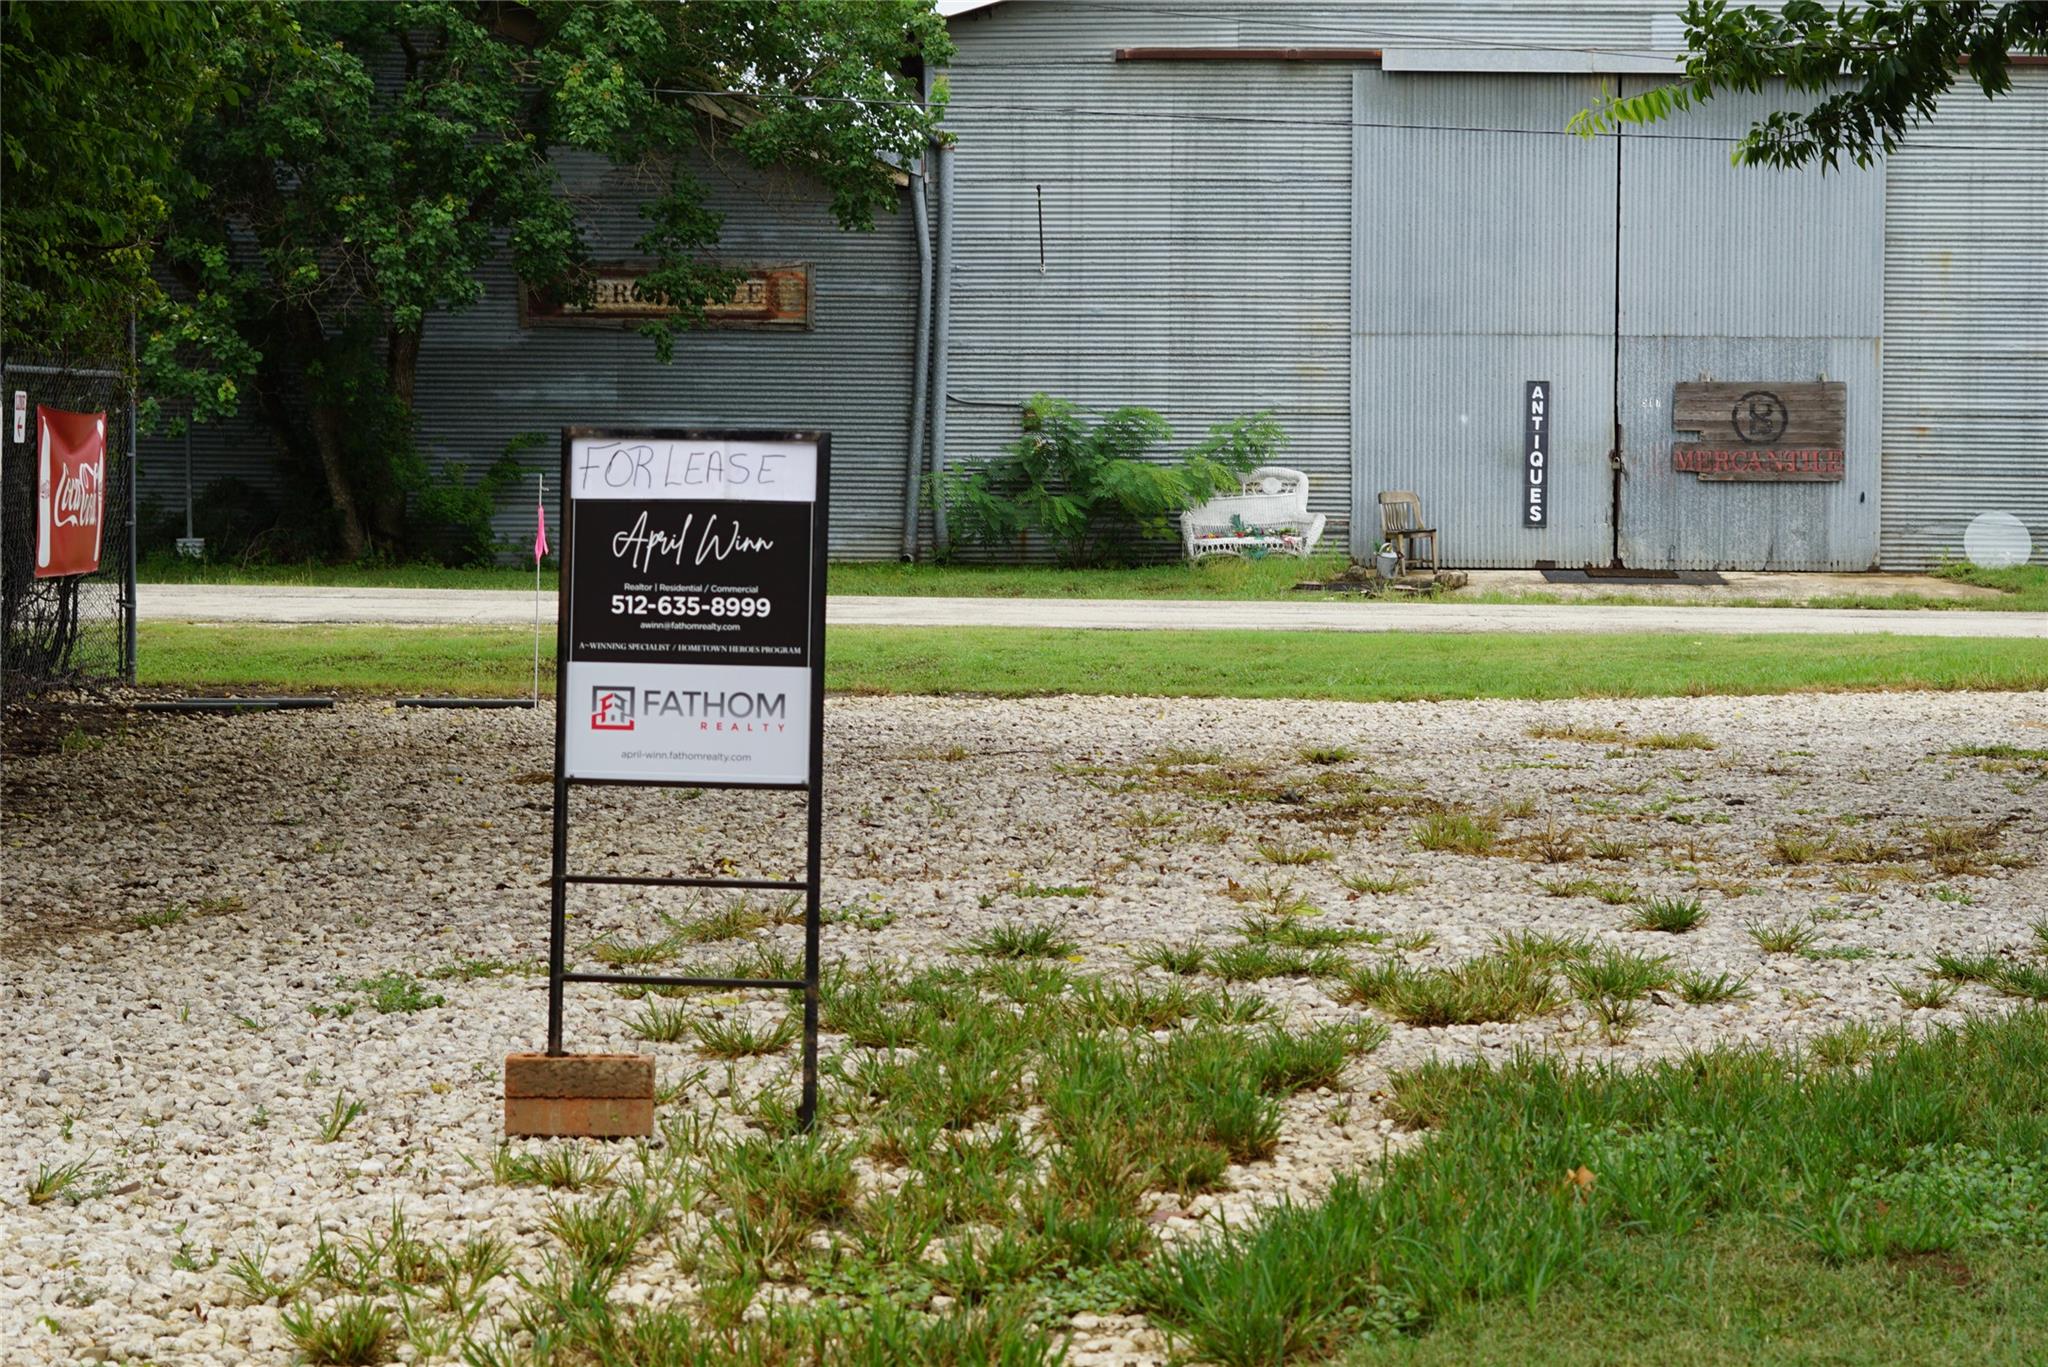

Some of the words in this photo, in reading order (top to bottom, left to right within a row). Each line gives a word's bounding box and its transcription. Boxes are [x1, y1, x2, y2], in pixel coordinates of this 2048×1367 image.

[579, 442, 654, 489] FOR
[665, 444, 786, 488] LEASE
[1529, 386, 1544, 522] ANTIQUES
[1675, 449, 1845, 474] MERCANTILE
[612, 510, 694, 573] April
[695, 514, 774, 565] Winn
[624, 582, 652, 592] Realtor
[659, 583, 702, 593] Residential
[710, 585, 759, 594] Commercial
[611, 595, 771, 618] 512-635-8999
[640, 621, 740, 632] awinn@fathomrealty.com
[628, 643, 671, 652] SPECIALIST
[678, 644, 728, 653] HOMETOWN
[728, 645, 760, 654] HEROES
[761, 646, 801, 655] PROGRAM
[643, 690, 786, 720] FATHOM
[700, 721, 785, 733] REALTY
[621, 749, 752, 763] april-winn.fathomrealty.com
